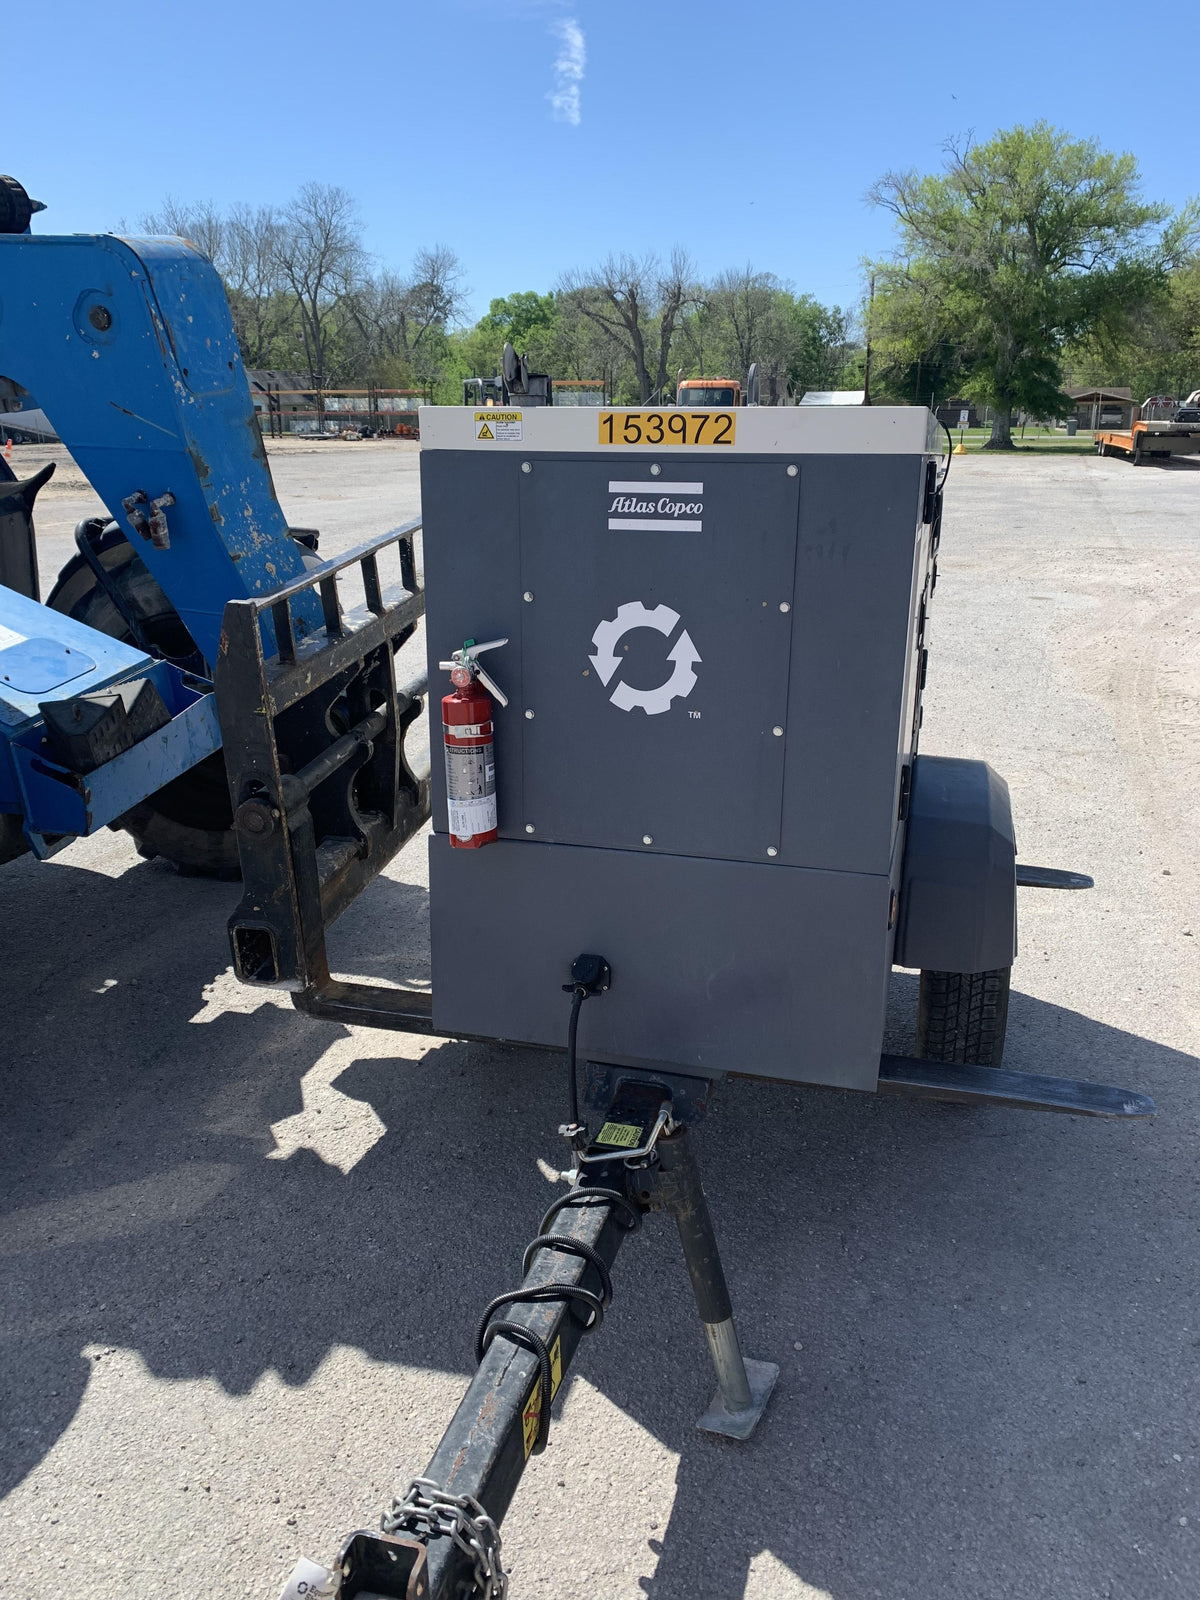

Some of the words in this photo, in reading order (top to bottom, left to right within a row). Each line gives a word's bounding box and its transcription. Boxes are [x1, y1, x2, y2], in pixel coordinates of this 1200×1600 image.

[486, 413, 517, 421] CAUTION
[602, 414, 732, 445] 153972
[608, 496, 655, 514] Atlas
[657, 498, 703, 517] Copco
